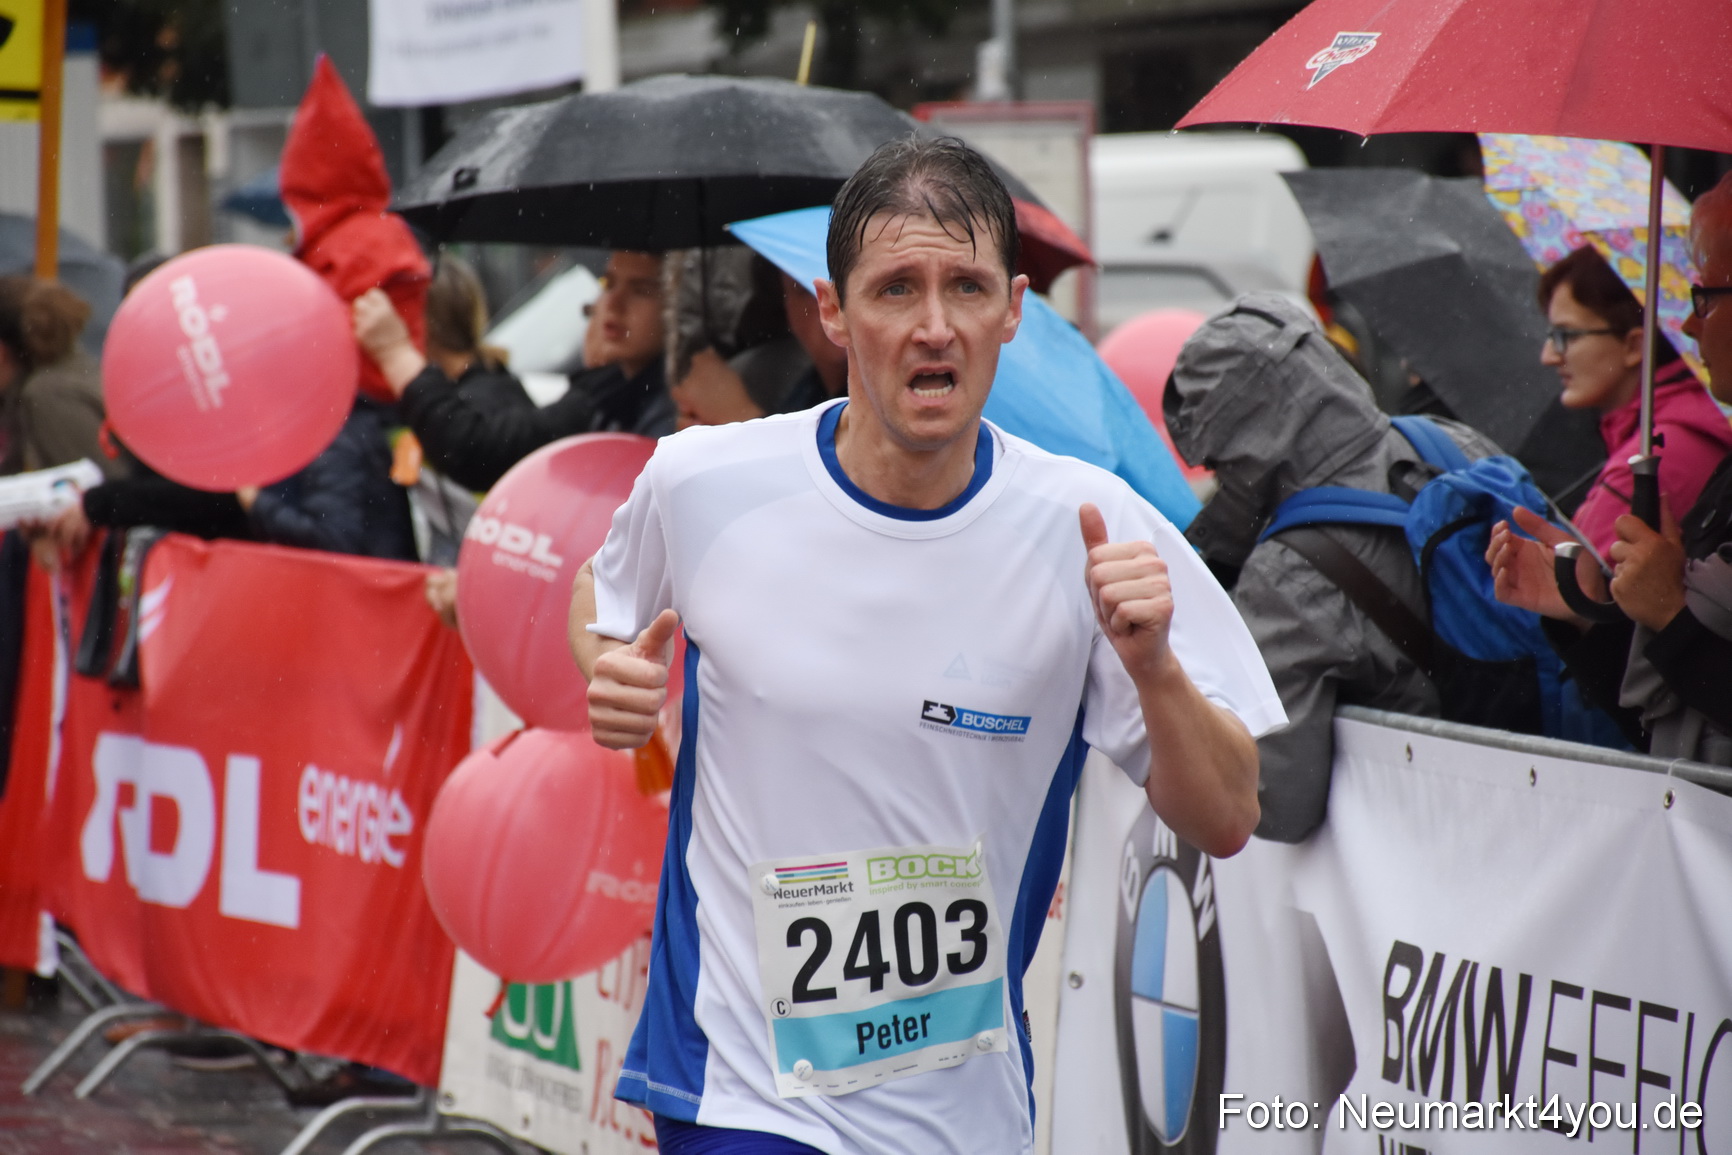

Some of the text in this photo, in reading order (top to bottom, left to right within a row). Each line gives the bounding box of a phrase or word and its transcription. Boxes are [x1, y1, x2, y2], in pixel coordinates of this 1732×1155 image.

[961, 711, 1025, 732] BÜSCHEL
[866, 853, 982, 886] BOCK
[773, 880, 855, 900] NeuerMarkt
[869, 883, 904, 896] inspired
[906, 881, 919, 891] by
[920, 880, 948, 889] smart
[786, 898, 989, 1004] 2403
[776, 1000, 787, 1016] C
[856, 1012, 931, 1055] Peter
[1382, 939, 1533, 1118] BMW
